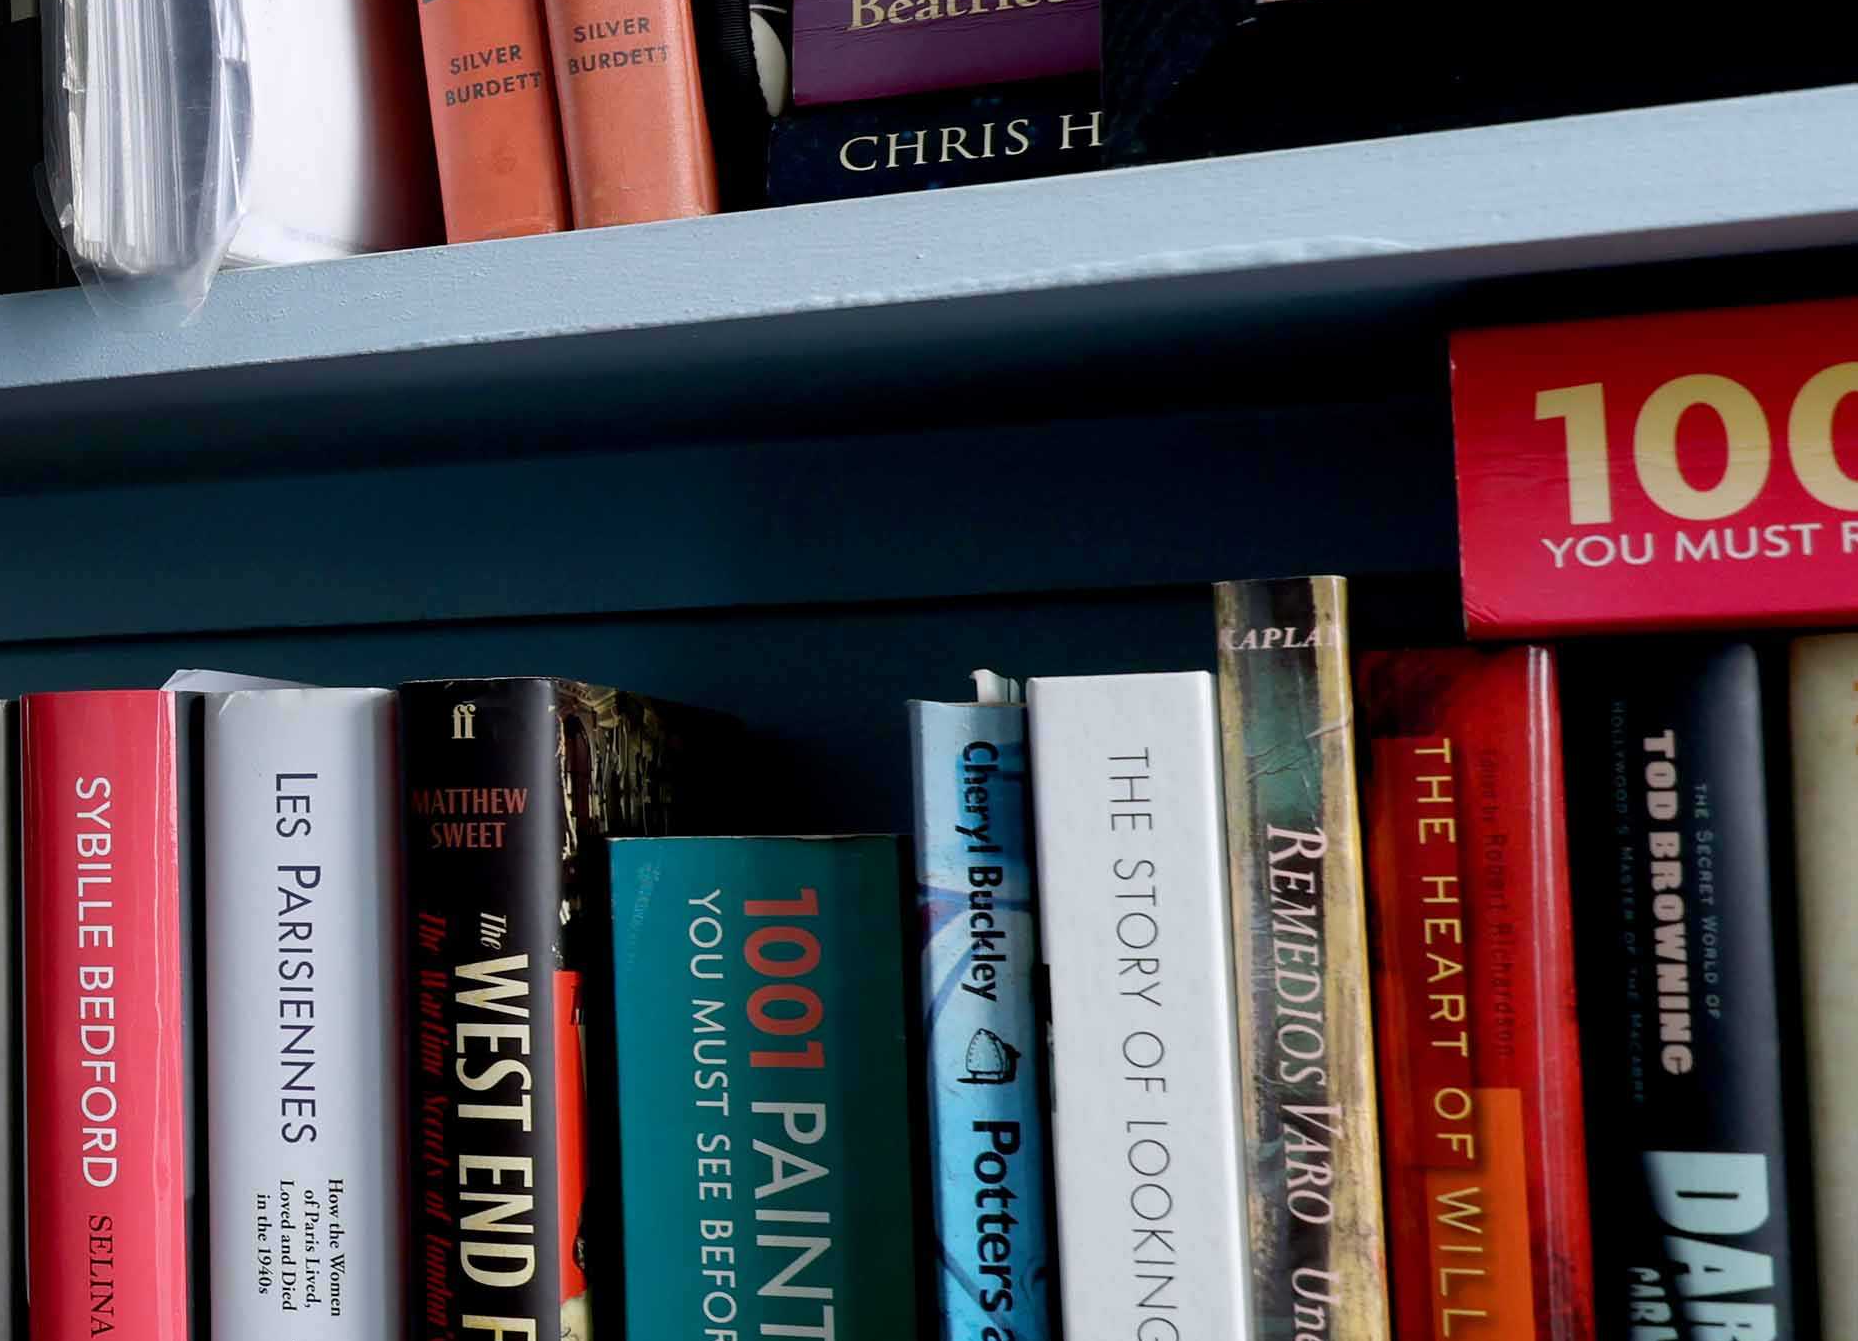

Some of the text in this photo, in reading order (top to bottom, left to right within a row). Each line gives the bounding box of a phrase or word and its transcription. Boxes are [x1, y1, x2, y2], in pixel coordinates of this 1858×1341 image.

[567, 44, 669, 77] BURDETT
[573, 15, 651, 44] SILVER
[839, 119, 1031, 172] CHRIS
[411, 788, 528, 816] MATTHEW
[430, 822, 507, 850] SWEET
[1108, 748, 1154, 831] THE
[76, 776, 113, 949] SYBILLE
[275, 772, 321, 1145] LES PARISIENNES
[480, 912, 507, 951] The
[1112, 859, 1162, 1007] STORY
[78, 965, 118, 1188] BEDFORD
[454, 953, 532, 1132] WEST
[1122, 1031, 1167, 1093] OF
[88, 1214, 116, 1338] SELINA
[257, 1195, 273, 1295] in the 1940s
[280, 1178, 299, 1312] Loved and Died
[303, 1189, 323, 1309] of Paris Lived,
[327, 1178, 345, 1318] How the Women
[457, 1153, 536, 1289] END
